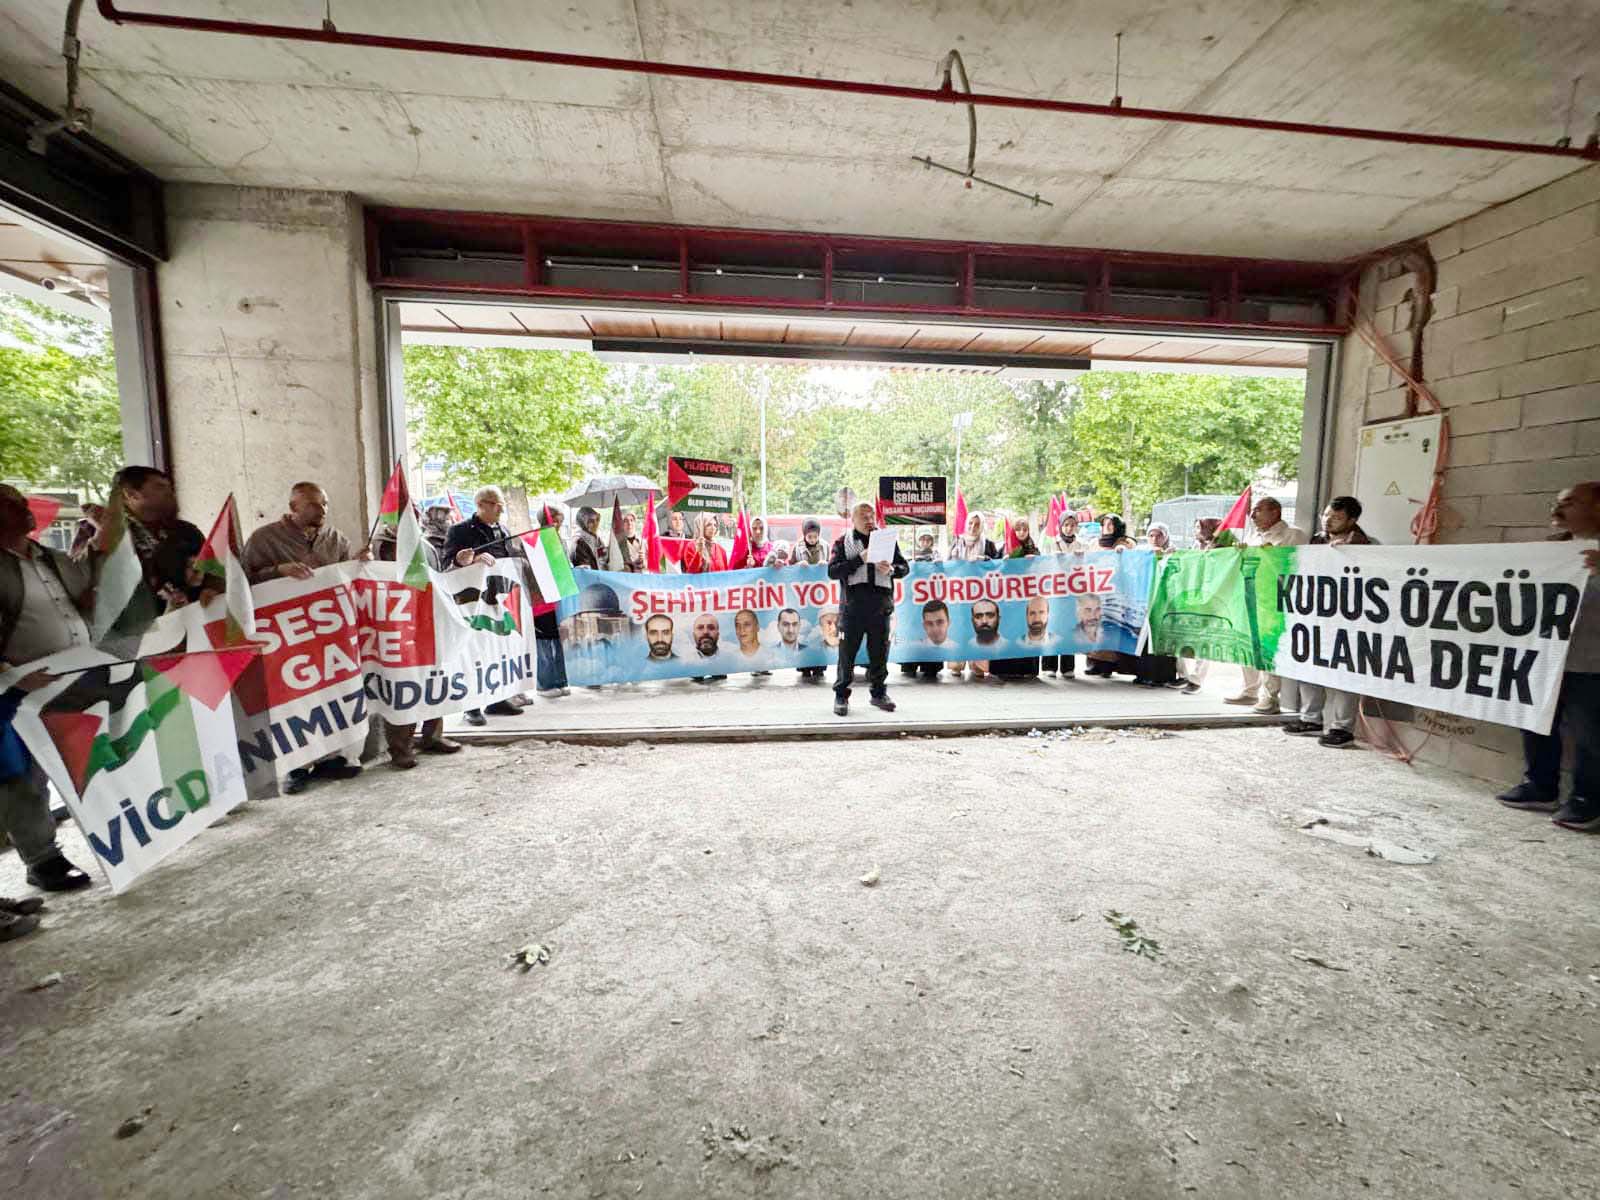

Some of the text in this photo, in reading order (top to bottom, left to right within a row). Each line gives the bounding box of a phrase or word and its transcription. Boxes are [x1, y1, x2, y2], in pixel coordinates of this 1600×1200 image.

[893, 479, 933, 491] İSRAİL İLE
[253, 581, 412, 655] SESİMİZ
[632, 579, 783, 621] ŞEHİTLERİN
[914, 567, 1113, 602] SÜRDÜRECEĞİZ
[1276, 566, 1580, 640] KUDÜS ÖZGÜR
[281, 626, 402, 690] GAZE
[474, 653, 533, 696] İÇİN!
[1291, 623, 1539, 705] OLANA DEK
